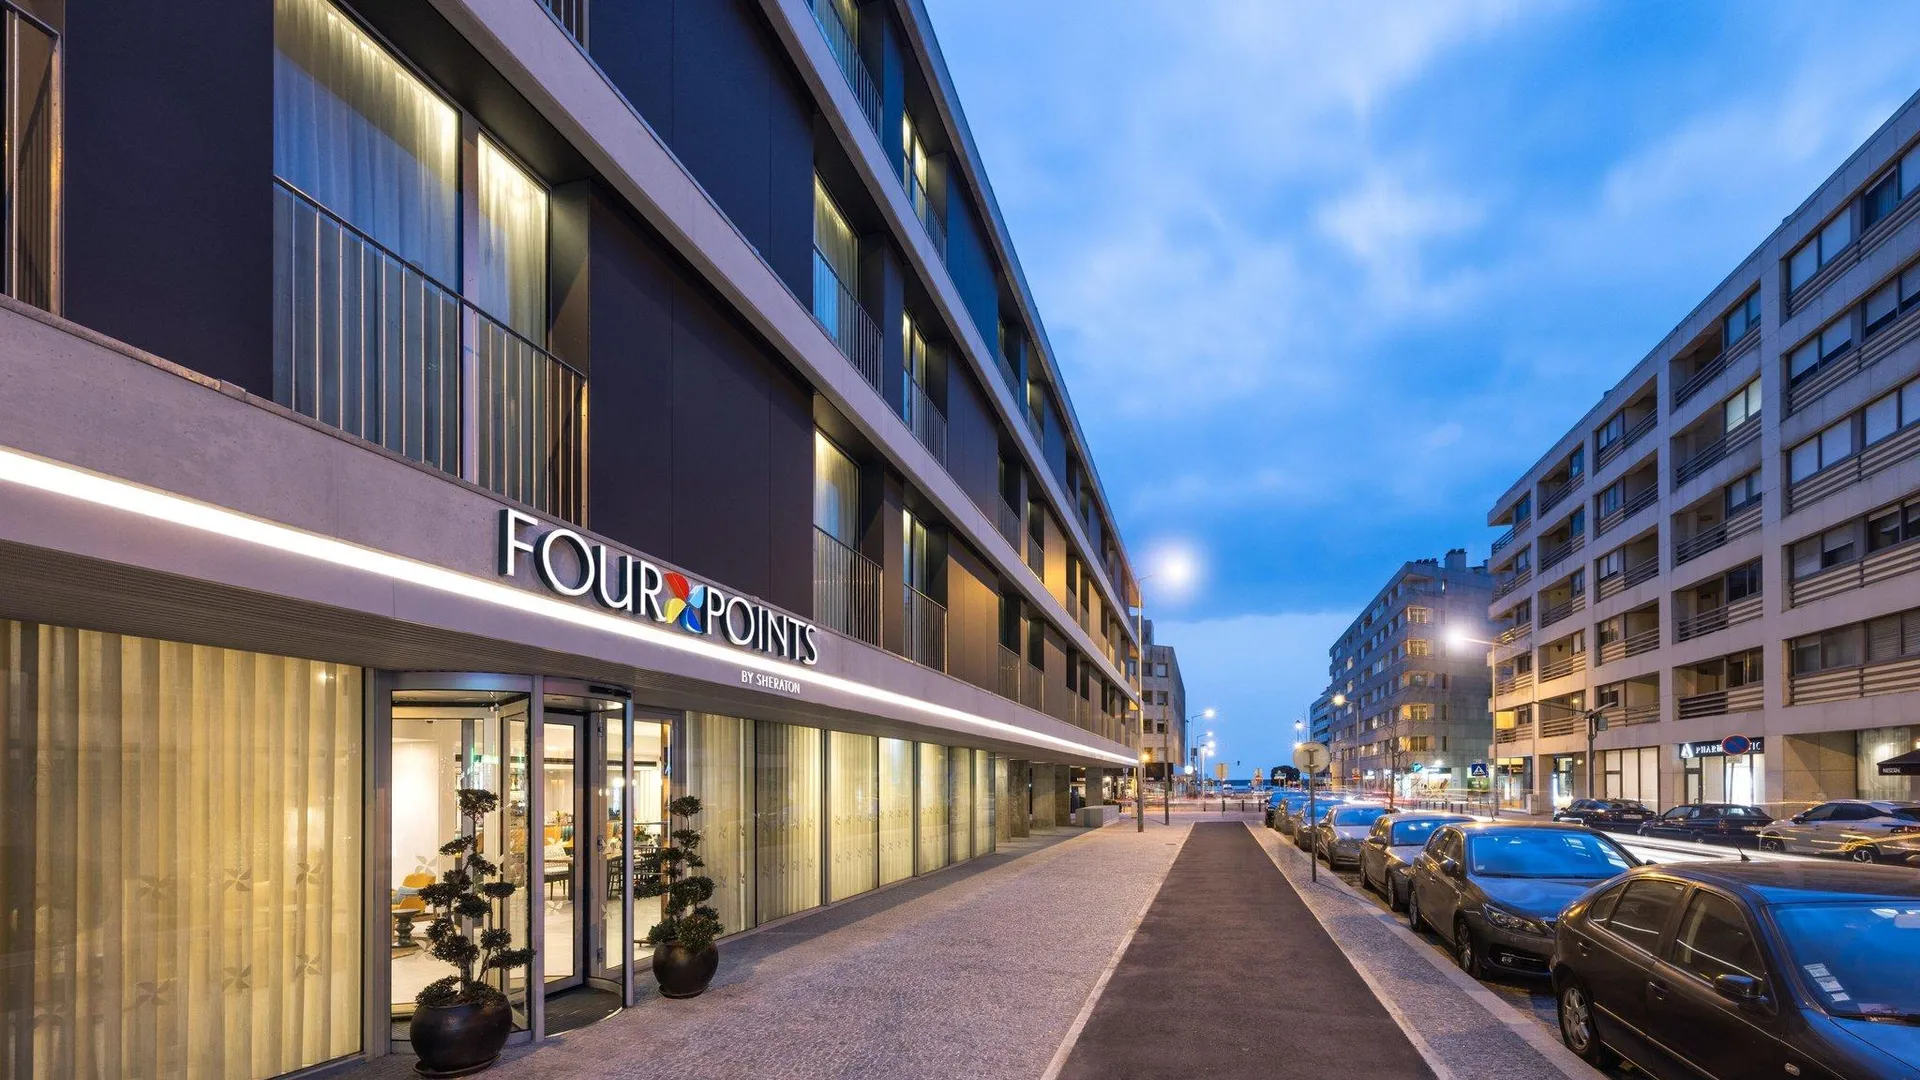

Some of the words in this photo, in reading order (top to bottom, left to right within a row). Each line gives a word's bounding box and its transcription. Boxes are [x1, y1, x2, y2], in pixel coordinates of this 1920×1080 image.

[499, 508, 667, 622] FOUR
[701, 585, 818, 665] POINTS
[741, 670, 754, 684] BY
[756, 673, 801, 694] SHERATON
